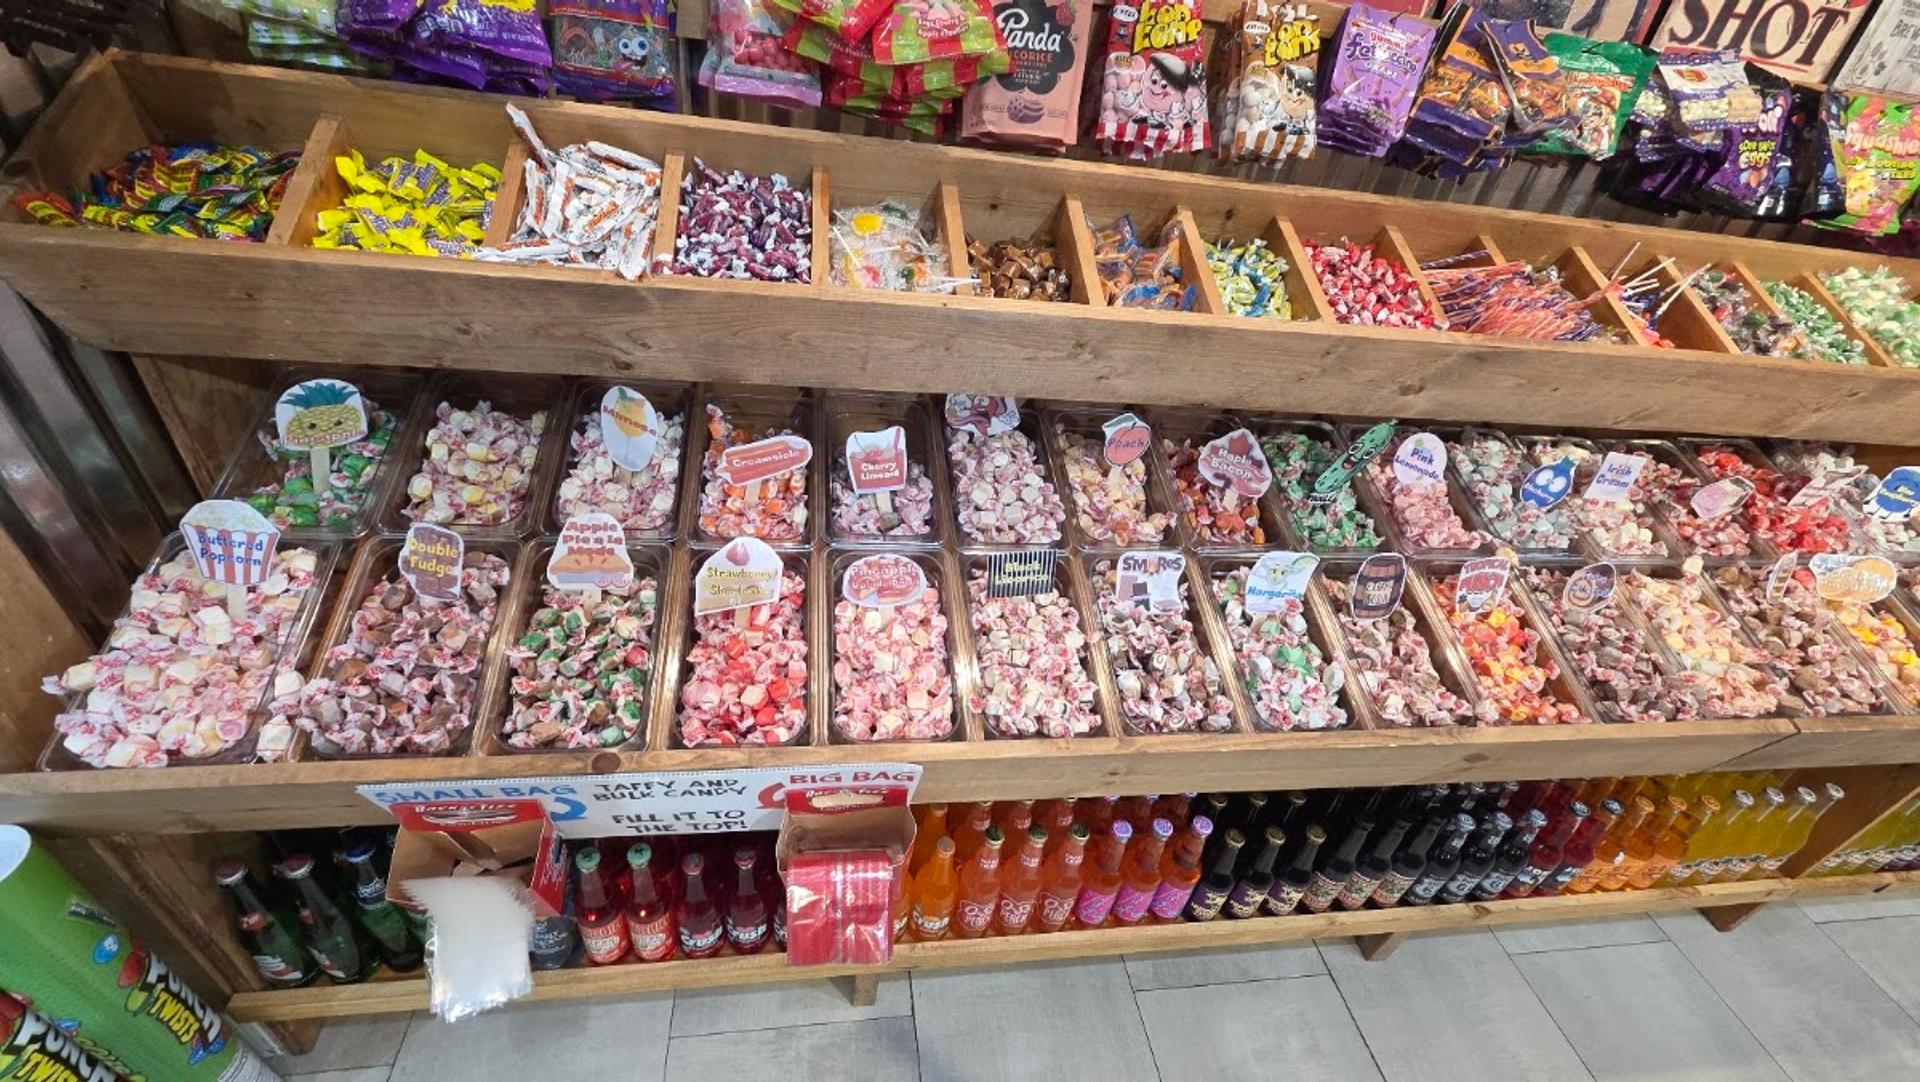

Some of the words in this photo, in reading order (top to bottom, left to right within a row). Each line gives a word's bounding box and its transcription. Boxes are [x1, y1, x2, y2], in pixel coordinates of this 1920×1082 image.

[996, 8, 1062, 51] Panda
[1669, 0, 1849, 66] SHOT
[1345, 31, 1417, 75] fetccine
[602, 404, 657, 437] Mimosa
[1107, 439, 1145, 450] Peach
[732, 449, 800, 468] Creamsicle
[1218, 447, 1252, 465] Maple
[1410, 447, 1435, 466] Pink
[861, 461, 897, 472] Cherry
[1210, 457, 1252, 480] Bacon
[1395, 454, 1440, 481] Lemonade
[1607, 463, 1633, 477] Irish
[1596, 475, 1630, 489] Cream
[566, 520, 618, 533] Apple
[198, 532, 263, 553] Buttered
[410, 537, 459, 559] Double
[562, 534, 591, 546] Pie
[200, 548, 262, 567] Popcorn
[408, 555, 453, 578] Fudge
[850, 563, 920, 579] Pineapple
[1247, 586, 1304, 601] Margarita
[594, 780, 677, 792] TAFFY
[689, 778, 740, 788] AND
[789, 773, 842, 785] BIG
[852, 770, 915, 783] BAG
[374, 787, 495, 804] SMALL
[500, 784, 578, 797] BAG
[592, 789, 656, 802] BULK
[662, 785, 748, 798] CANDY
[611, 812, 665, 825] FILL
[671, 811, 699, 823] IT
[706, 808, 747, 821] TO
[625, 824, 678, 834] THE
[692, 819, 748, 832] TOP!
[149, 989, 201, 1044] TWISTS
